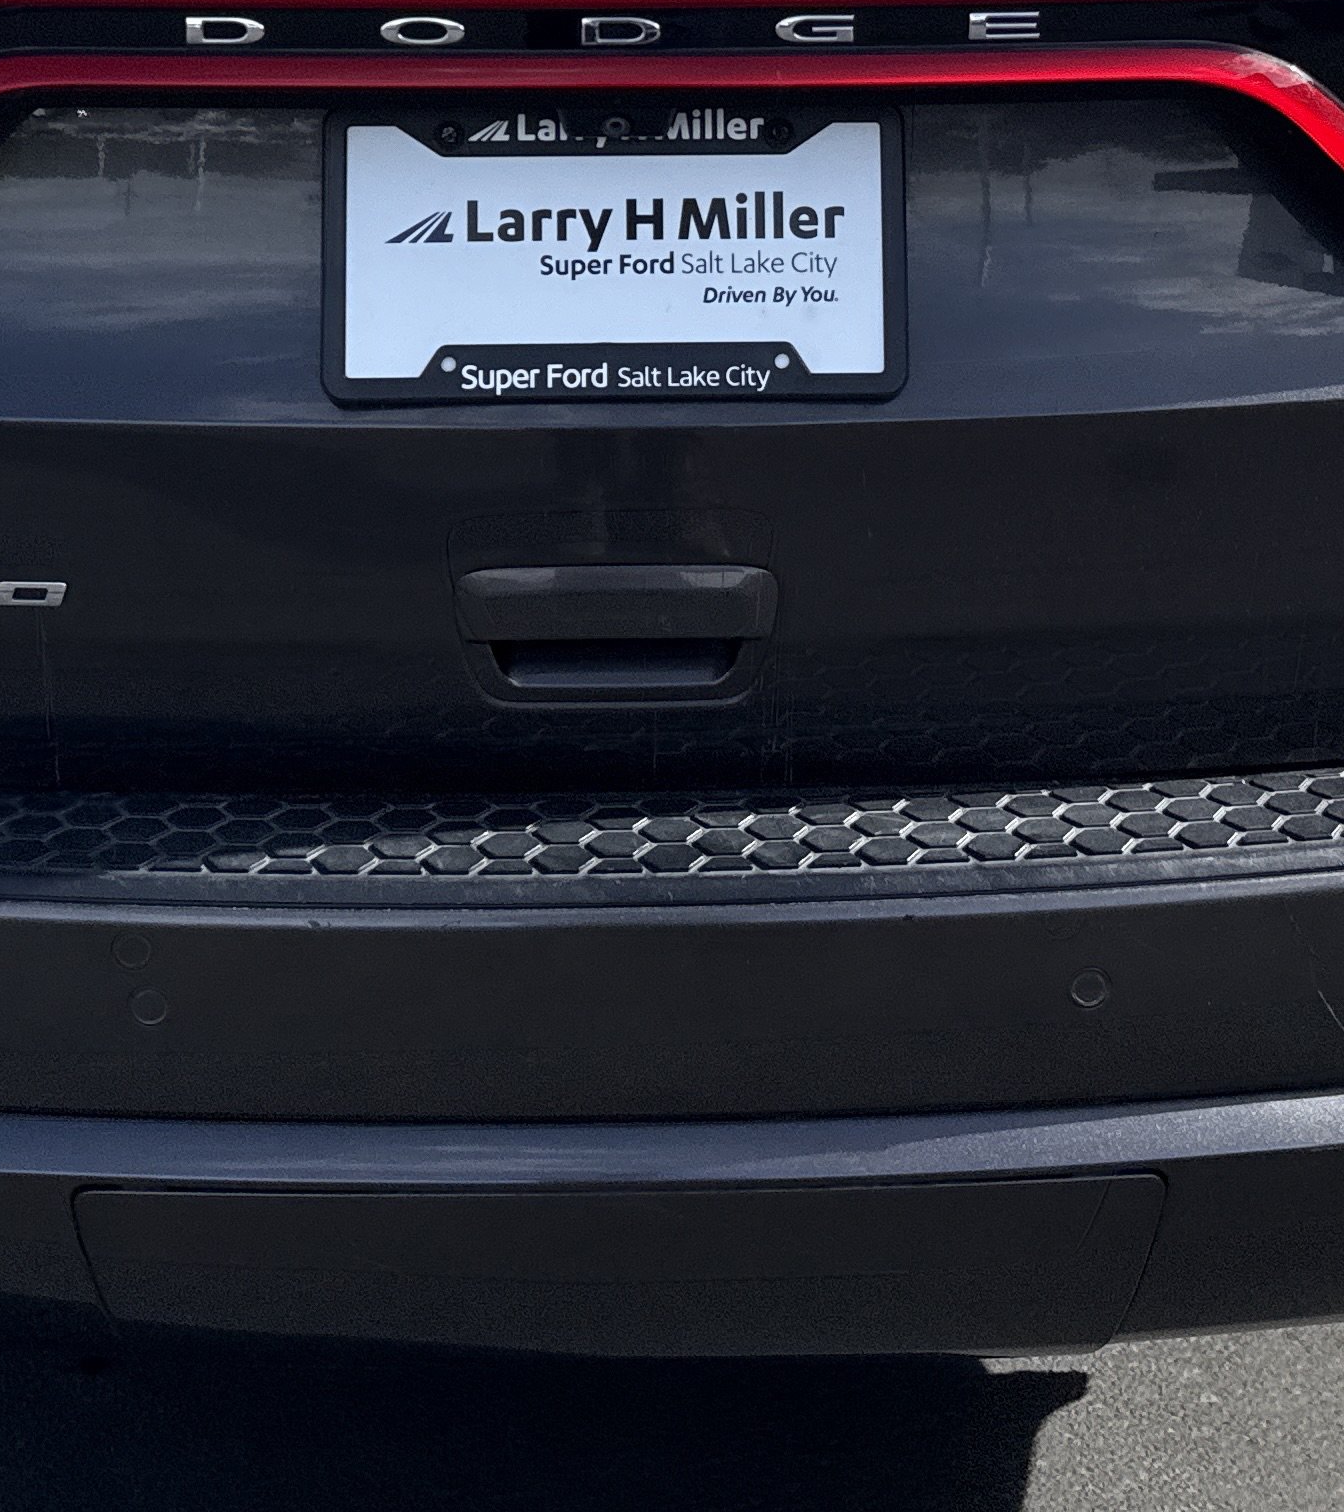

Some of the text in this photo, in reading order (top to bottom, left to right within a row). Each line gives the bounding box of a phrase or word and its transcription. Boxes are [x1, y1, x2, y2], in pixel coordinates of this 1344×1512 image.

[185, 11, 1040, 46] DODGE
[467, 191, 845, 252] Larry H Miller
[540, 250, 838, 280] Super Ford Salt Lake City
[703, 286, 839, 306] Driven By You.
[461, 362, 771, 396] Super Ford Salt Lake City
